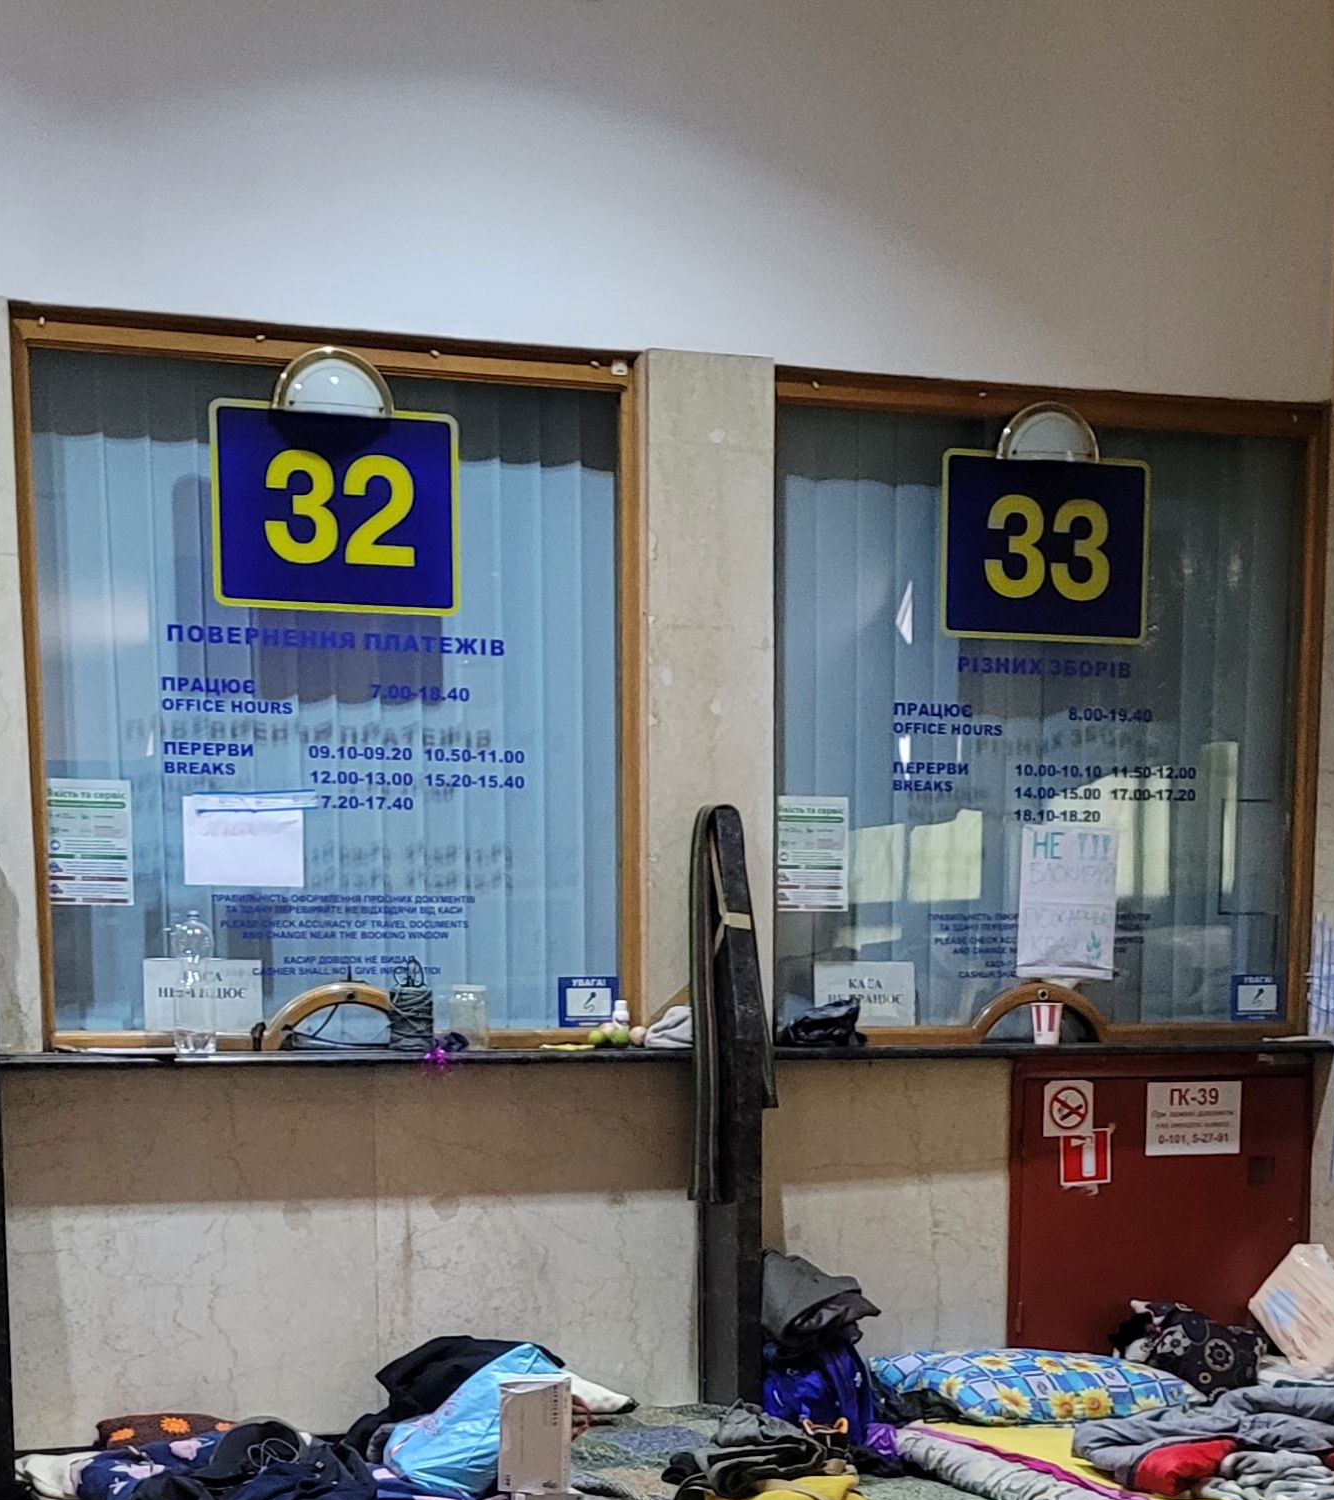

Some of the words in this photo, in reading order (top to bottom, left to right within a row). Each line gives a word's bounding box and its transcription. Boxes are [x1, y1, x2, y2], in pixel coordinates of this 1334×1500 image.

[264, 449, 417, 568] 32
[983, 494, 1111, 601] 33
[166, 623, 355, 650] ПОВЕРНЕННЯ
[364, 632, 506, 657] ПЛАТЕЖІВ
[958, 656, 1042, 675] РІЗНИХ
[1049, 659, 1132, 678] ЗБОРІВ
[161, 676, 255, 696] ПРАЦЮЄ
[371, 683, 470, 703] 7.00-18.40
[162, 698, 226, 713] OFFICE
[231, 701, 294, 715] HOURS
[893, 702, 973, 718] ПРАЦЮЄ
[1068, 707, 1153, 722] 8.00-19.40
[893, 721, 946, 735] OFFICE
[951, 723, 1003, 737] HOURS
[163, 741, 254, 758] ПЕРЕРВИ
[309, 745, 413, 762] 09.10-09.20
[424, 748, 525, 765] 10.50-11.00
[164, 761, 236, 776] BREAKS
[893, 762, 969, 776] ПЕРЕРВИ
[1015, 764, 1102, 778] 10.00-10.10
[1111, 766, 1196, 780] 11.50-12.00
[310, 770, 414, 788] 12.00-13.00
[424, 773, 525, 790] 15.20-15.40
[893, 779, 954, 793] BREAKS
[320, 794, 414, 811] 7.20-17.40
[1015, 787, 1101, 801] 14.00-15.00
[1110, 788, 1196, 802] 17.00-17.20
[1013, 809, 1101, 823] 18.10-18.20
[1031, 831, 1065, 860] НЕ
[298, 920, 351, 929] ACCURACY
[354, 920, 368, 929] OF
[371, 920, 407, 929] TRAVEL
[309, 931, 337, 940] NEAR
[339, 931, 357, 940] THE
[361, 931, 406, 940] BOOKING
[571, 978, 607, 987] УВАГА!
